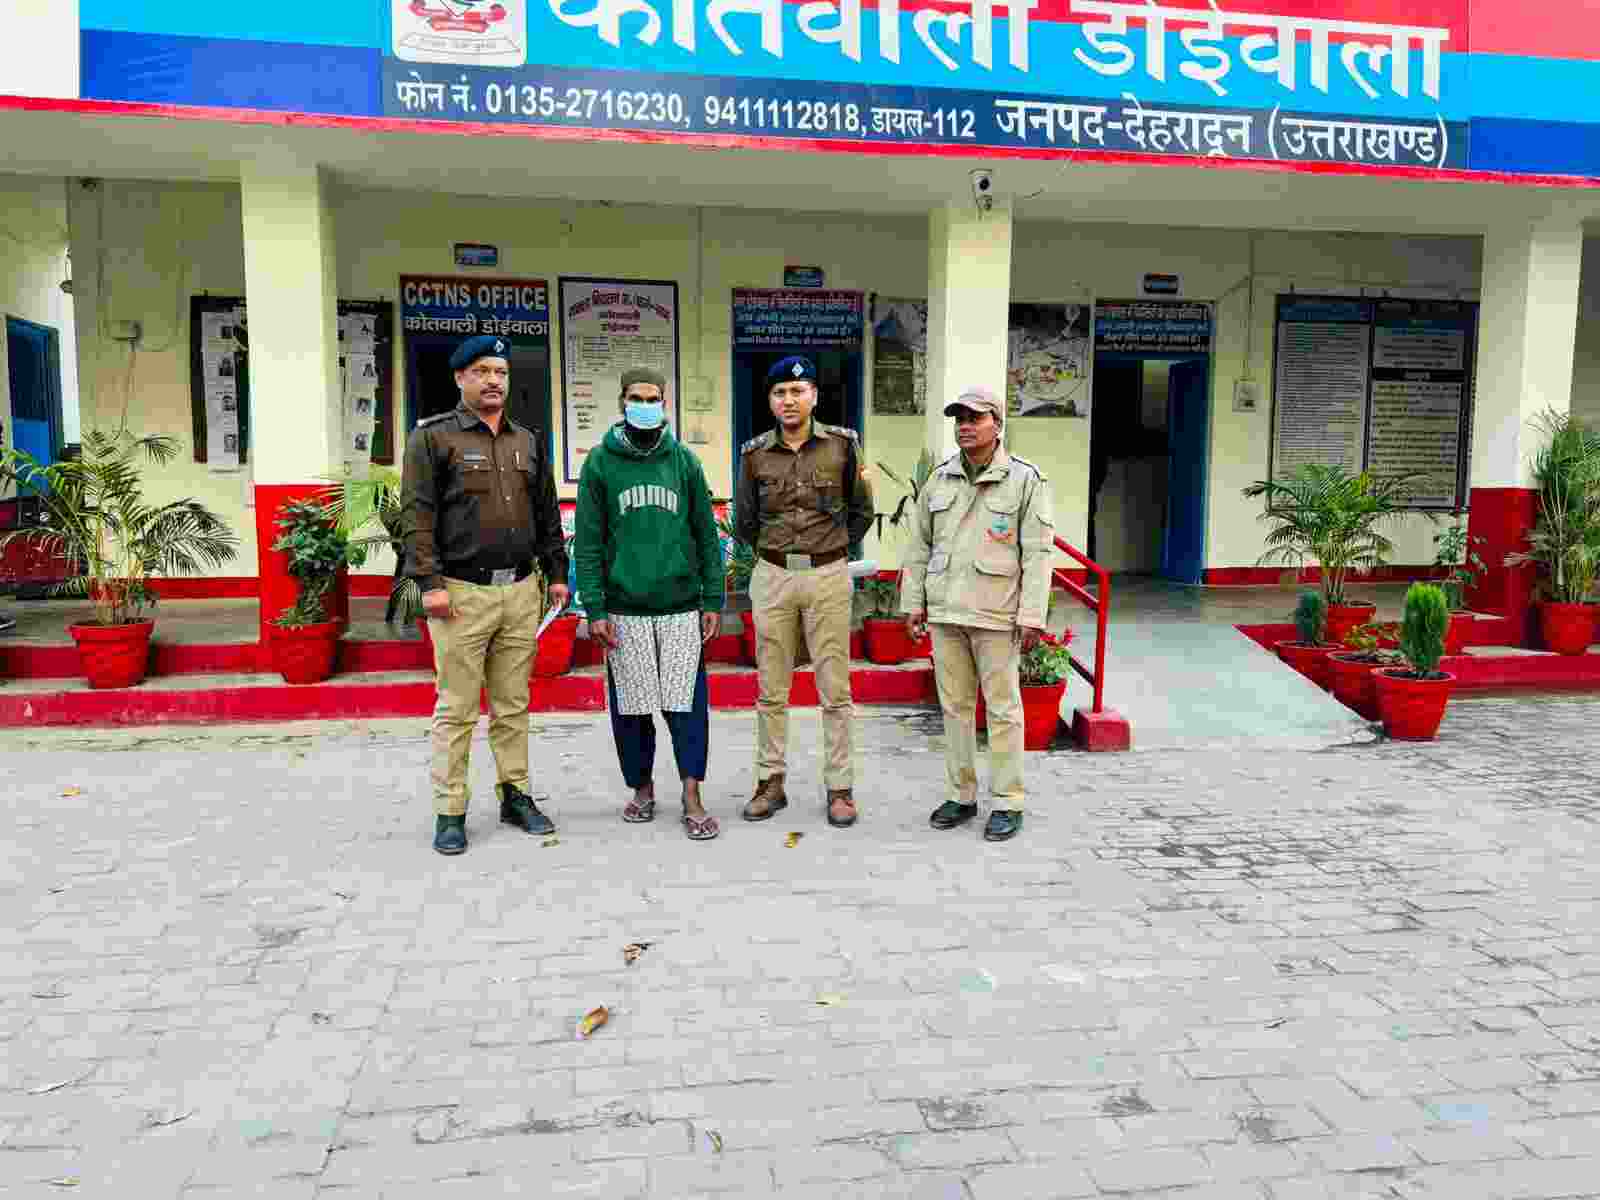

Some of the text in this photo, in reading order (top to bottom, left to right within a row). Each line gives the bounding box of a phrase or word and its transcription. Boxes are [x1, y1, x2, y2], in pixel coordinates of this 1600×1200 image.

[396, 70, 446, 111] फोन
[485, 83, 691, 128] 0135-2716230,
[1268, 102, 1448, 169] (उत्तराखण्ड)
[404, 281, 472, 308] CCTNS
[478, 285, 546, 311] OFFICE
[404, 312, 478, 334] कोतवाली
